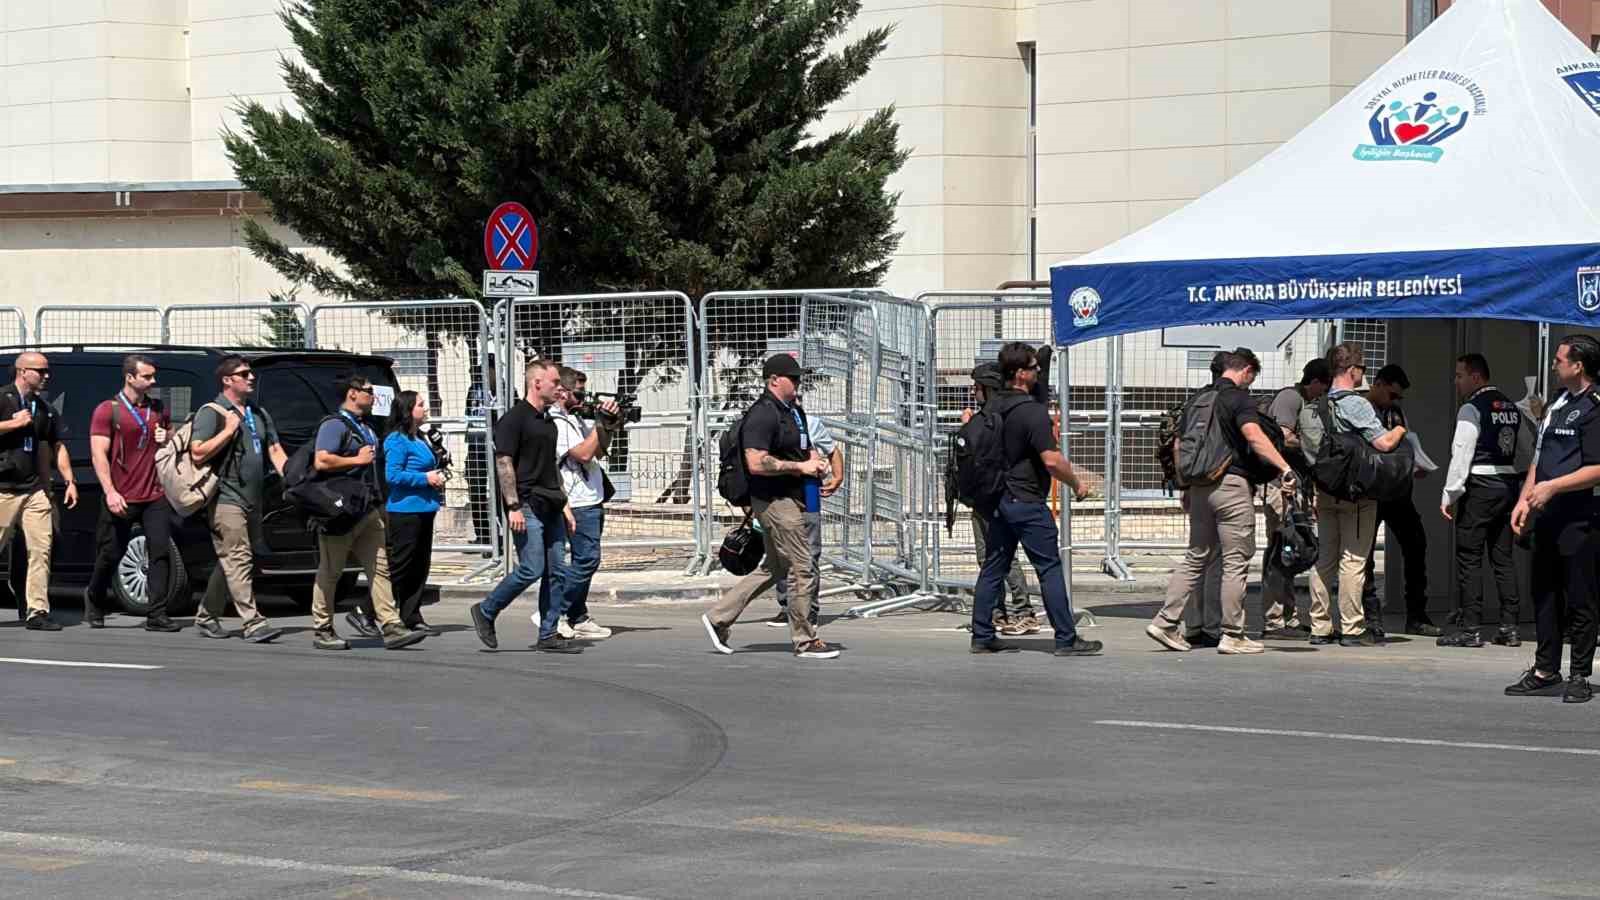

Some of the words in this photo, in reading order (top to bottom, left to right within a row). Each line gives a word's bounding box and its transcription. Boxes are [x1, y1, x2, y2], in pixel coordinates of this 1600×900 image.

[1187, 286, 1211, 302] T.C.
[1215, 284, 1275, 301] ANKARA
[1278, 277, 1373, 301] BÜYÜKŞEHİR
[1376, 273, 1462, 297] BELEDİYESİ
